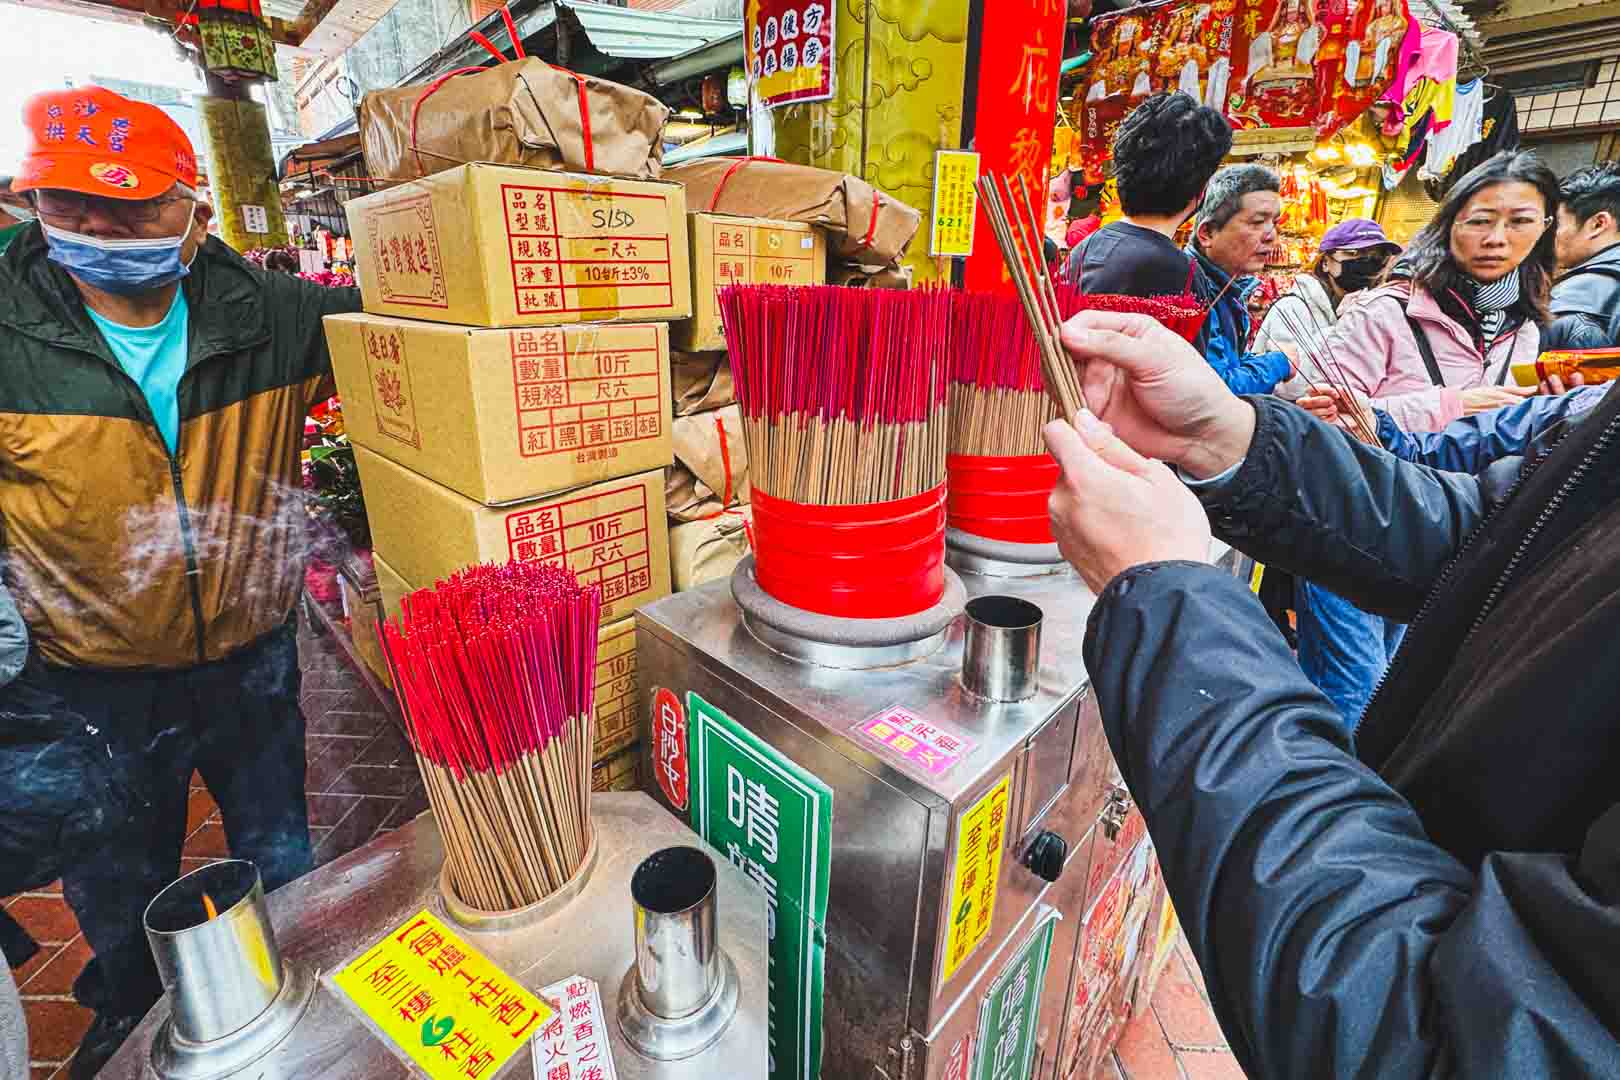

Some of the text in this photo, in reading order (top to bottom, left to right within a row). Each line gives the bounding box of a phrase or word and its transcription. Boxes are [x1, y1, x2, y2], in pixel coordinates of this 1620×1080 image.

[511, 192, 546, 210] 品名
[516, 212, 551, 232] 型號
[517, 239, 553, 258] 規格
[594, 242, 639, 258] 一尺六
[520, 266, 554, 283] 淨重
[769, 264, 793, 279] 10斤
[523, 292, 559, 308] 批號
[517, 331, 559, 353] 品名
[519, 358, 563, 381] 數量
[595, 354, 630, 375] 10斤
[521, 384, 564, 407] 規格
[595, 380, 630, 400] 尺六
[527, 431, 549, 452] 紅
[559, 426, 577, 446] 黑
[638, 415, 658, 434] 本色
[576, 447, 618, 464] 台灣製造
[515, 511, 555, 536] 品名
[589, 518, 623, 542] 10斤
[517, 535, 556, 560] 數量
[591, 542, 624, 566] 尺六
